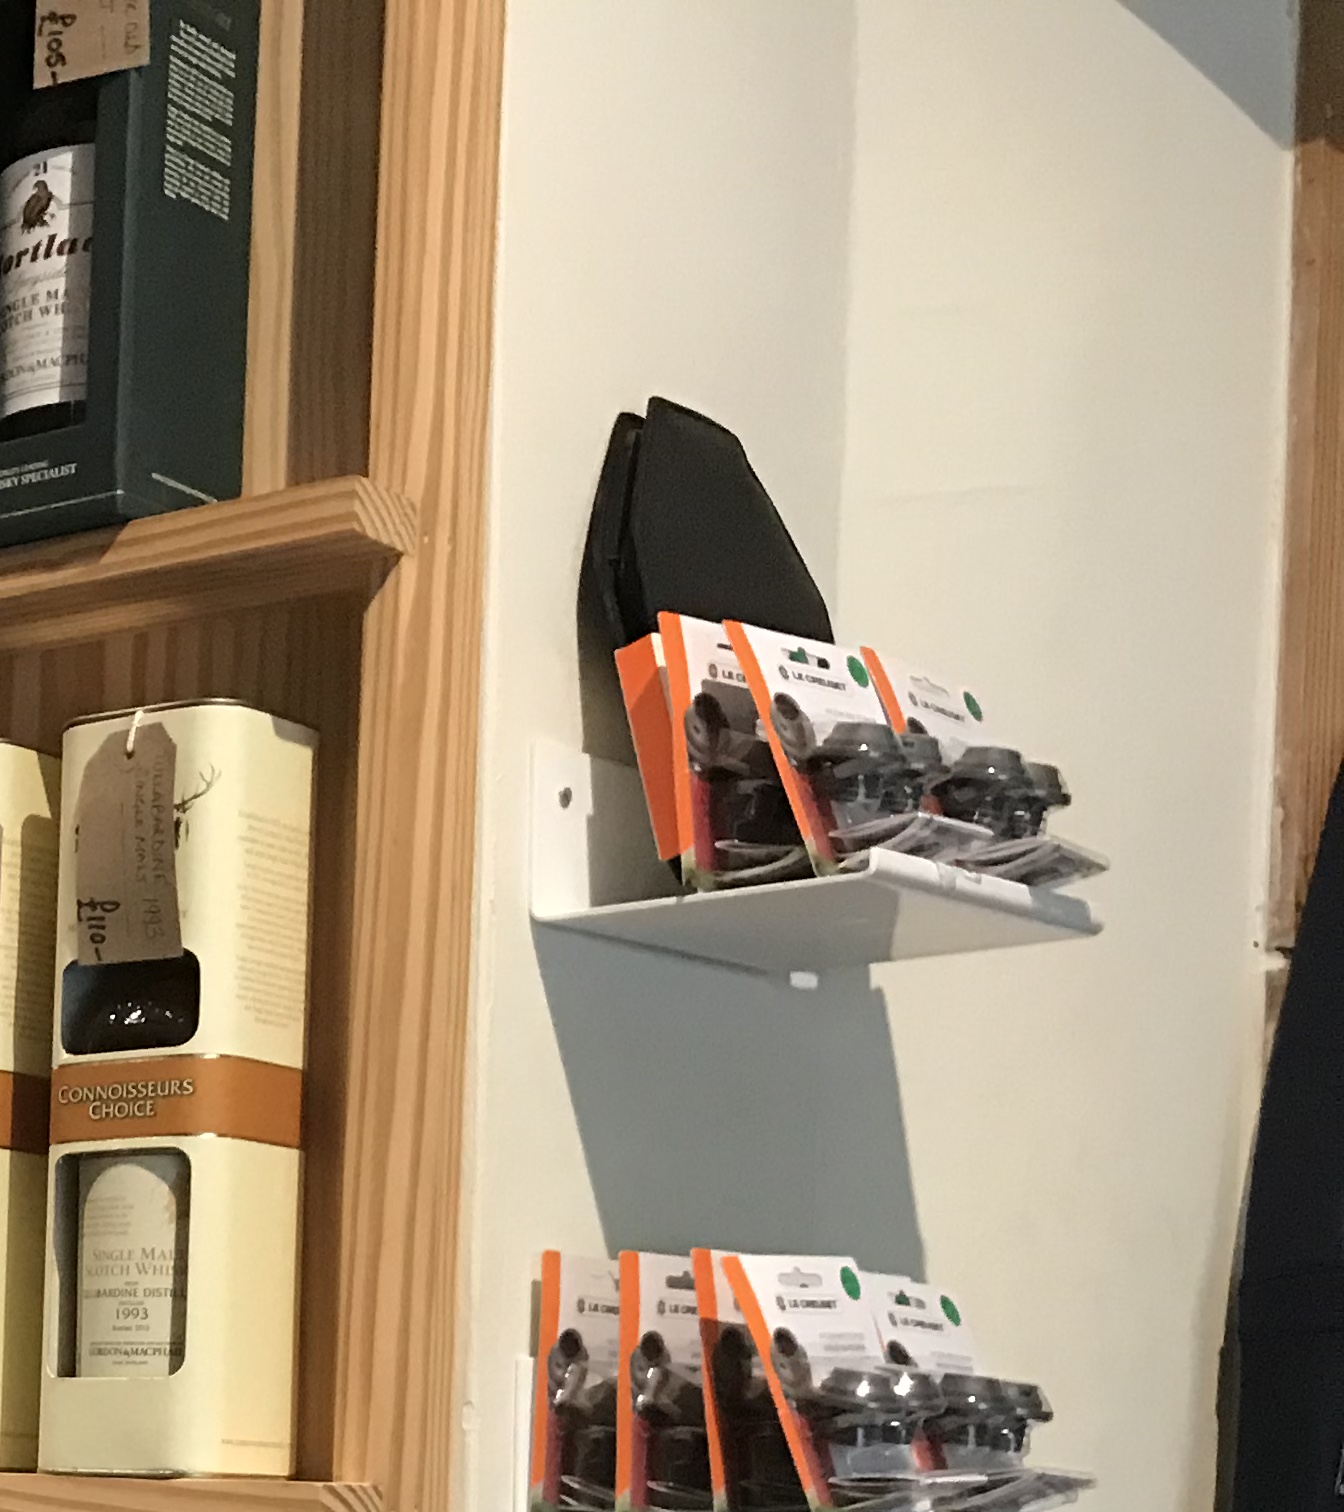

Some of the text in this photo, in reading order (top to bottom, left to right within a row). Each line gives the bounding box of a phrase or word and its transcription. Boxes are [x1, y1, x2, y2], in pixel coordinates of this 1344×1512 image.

[20, 463, 78, 486] SPECIALIST
[77, 898, 122, 962] £110-
[58, 1078, 194, 1105] CONNOISSEURS
[88, 1099, 155, 1121] CHOICE
[115, 1306, 149, 1321] 1993
